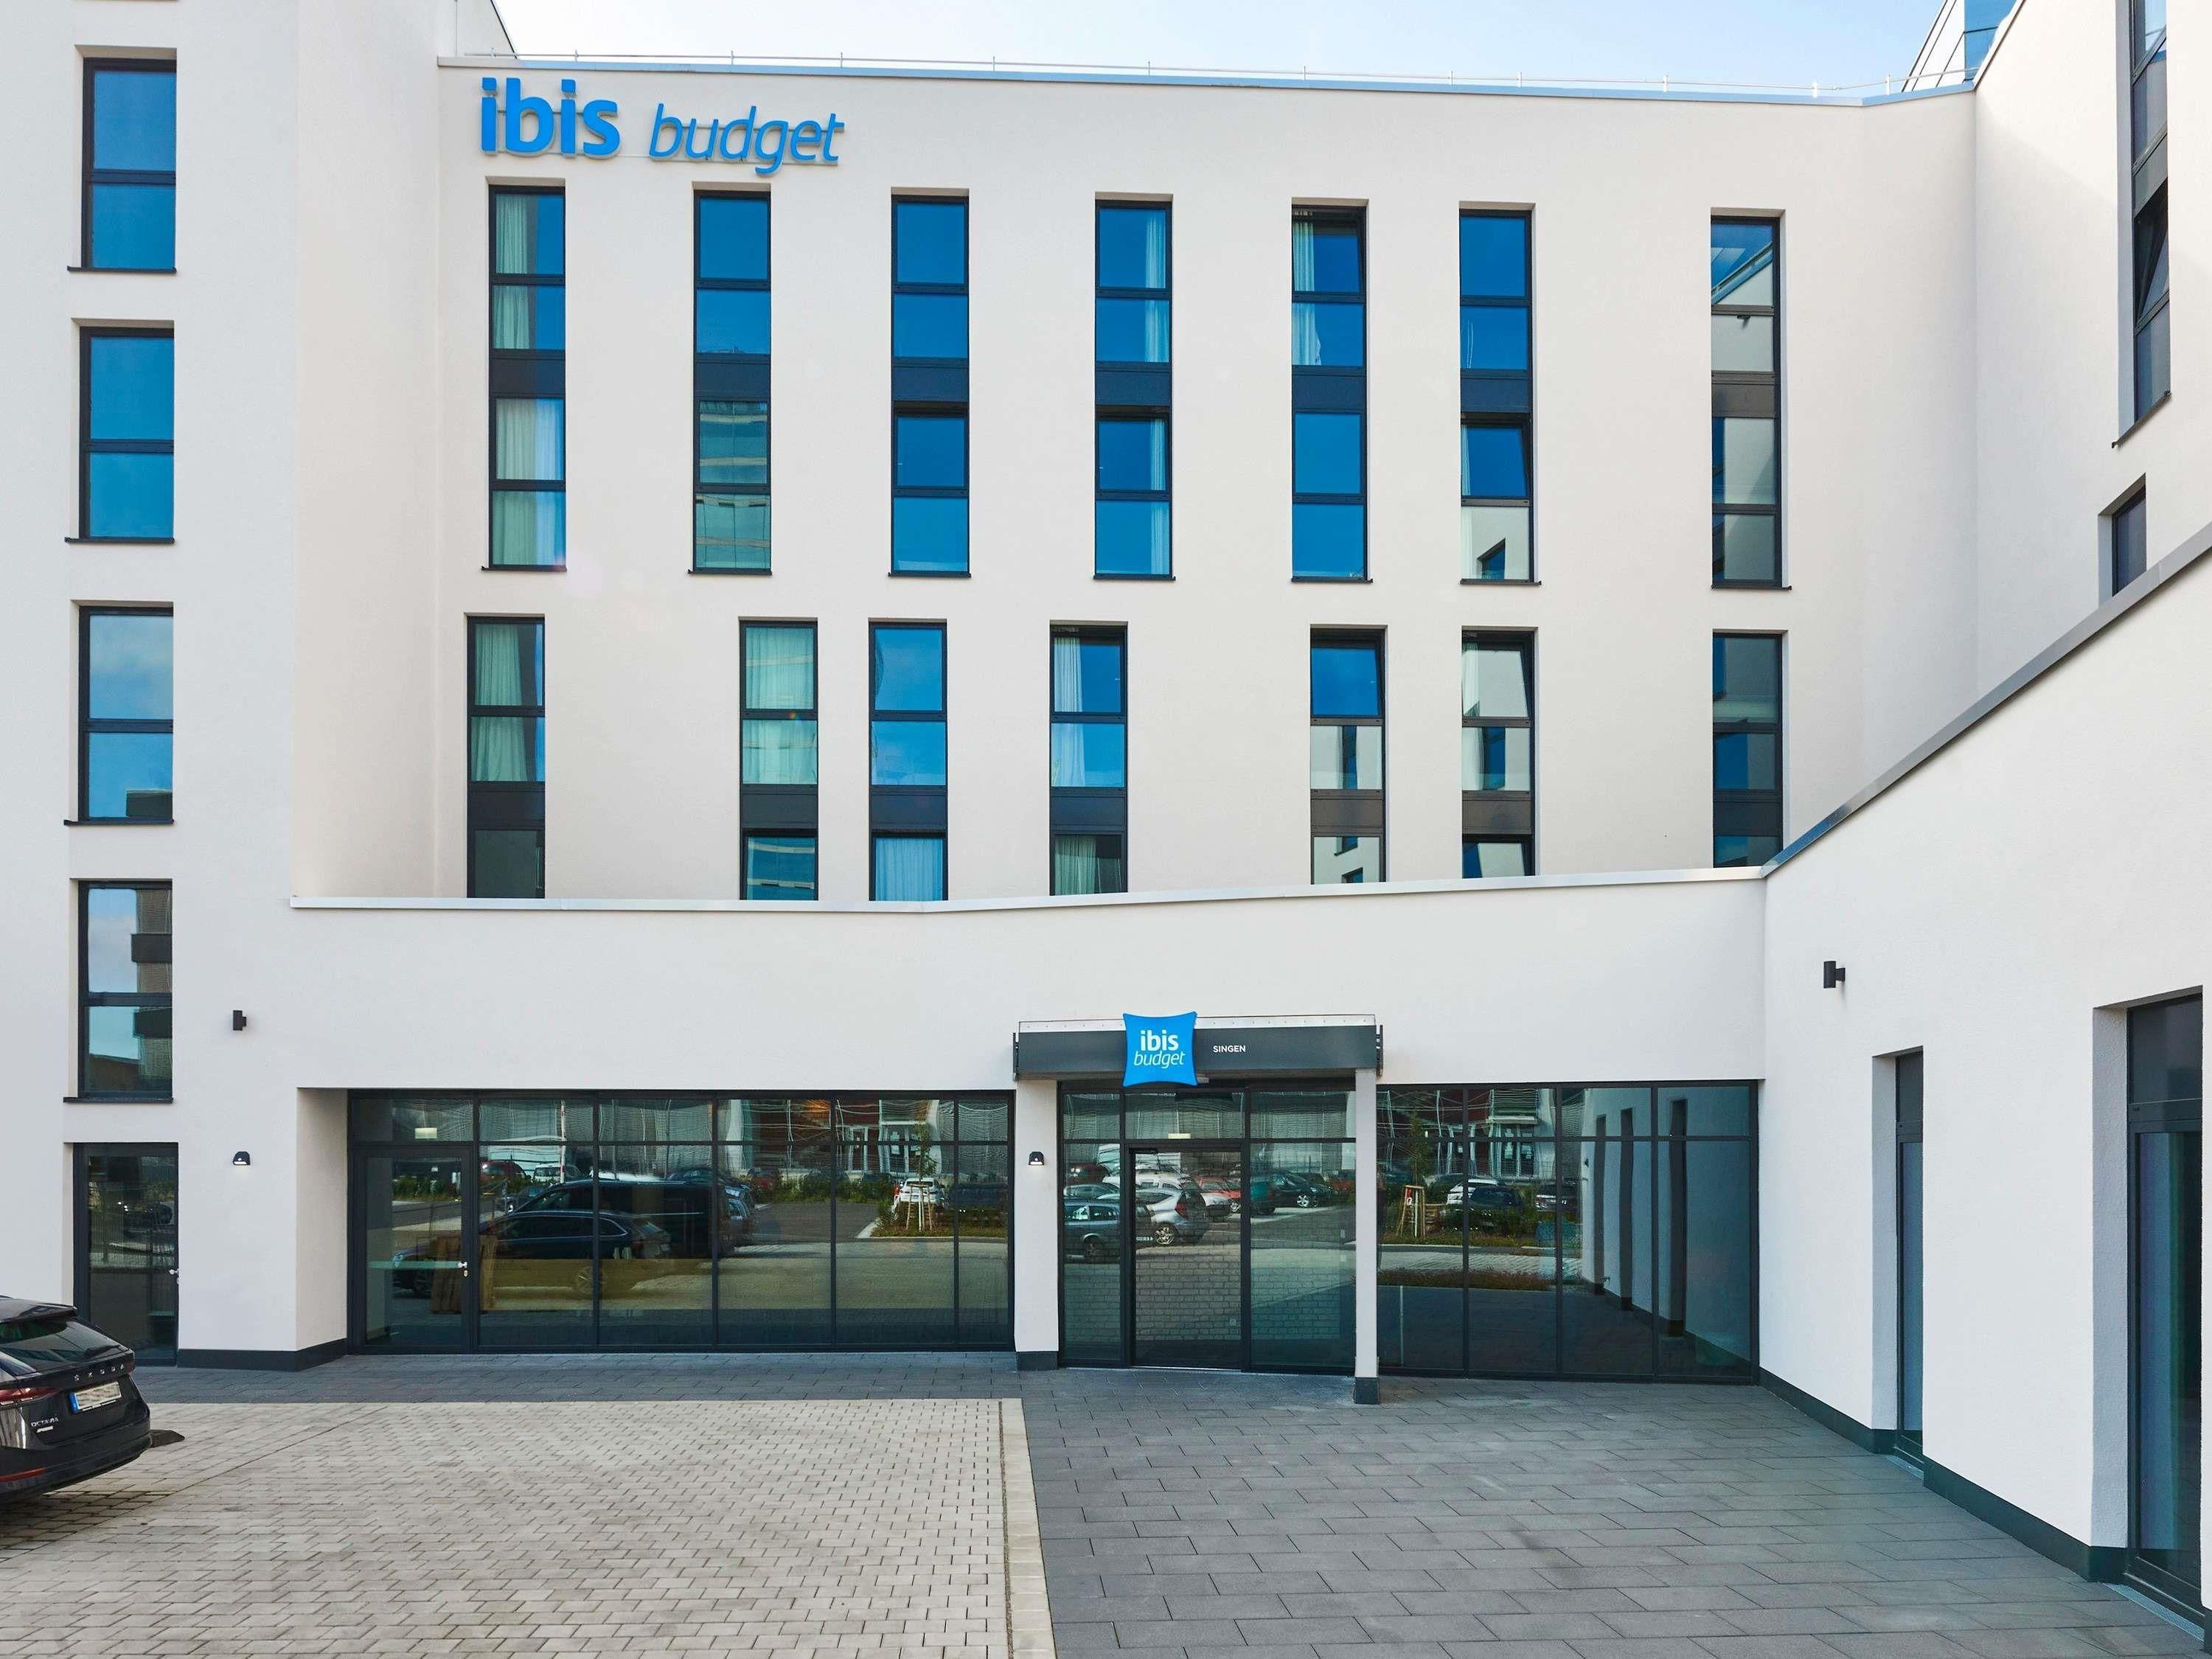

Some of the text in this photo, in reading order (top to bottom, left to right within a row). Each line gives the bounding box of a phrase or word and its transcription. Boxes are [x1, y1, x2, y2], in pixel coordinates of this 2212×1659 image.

[481, 77, 845, 177] ibis budget
[1140, 1029, 1179, 1051] ibis
[1213, 1045, 1246, 1053] SINGEN
[1133, 1051, 1186, 1069] budget
